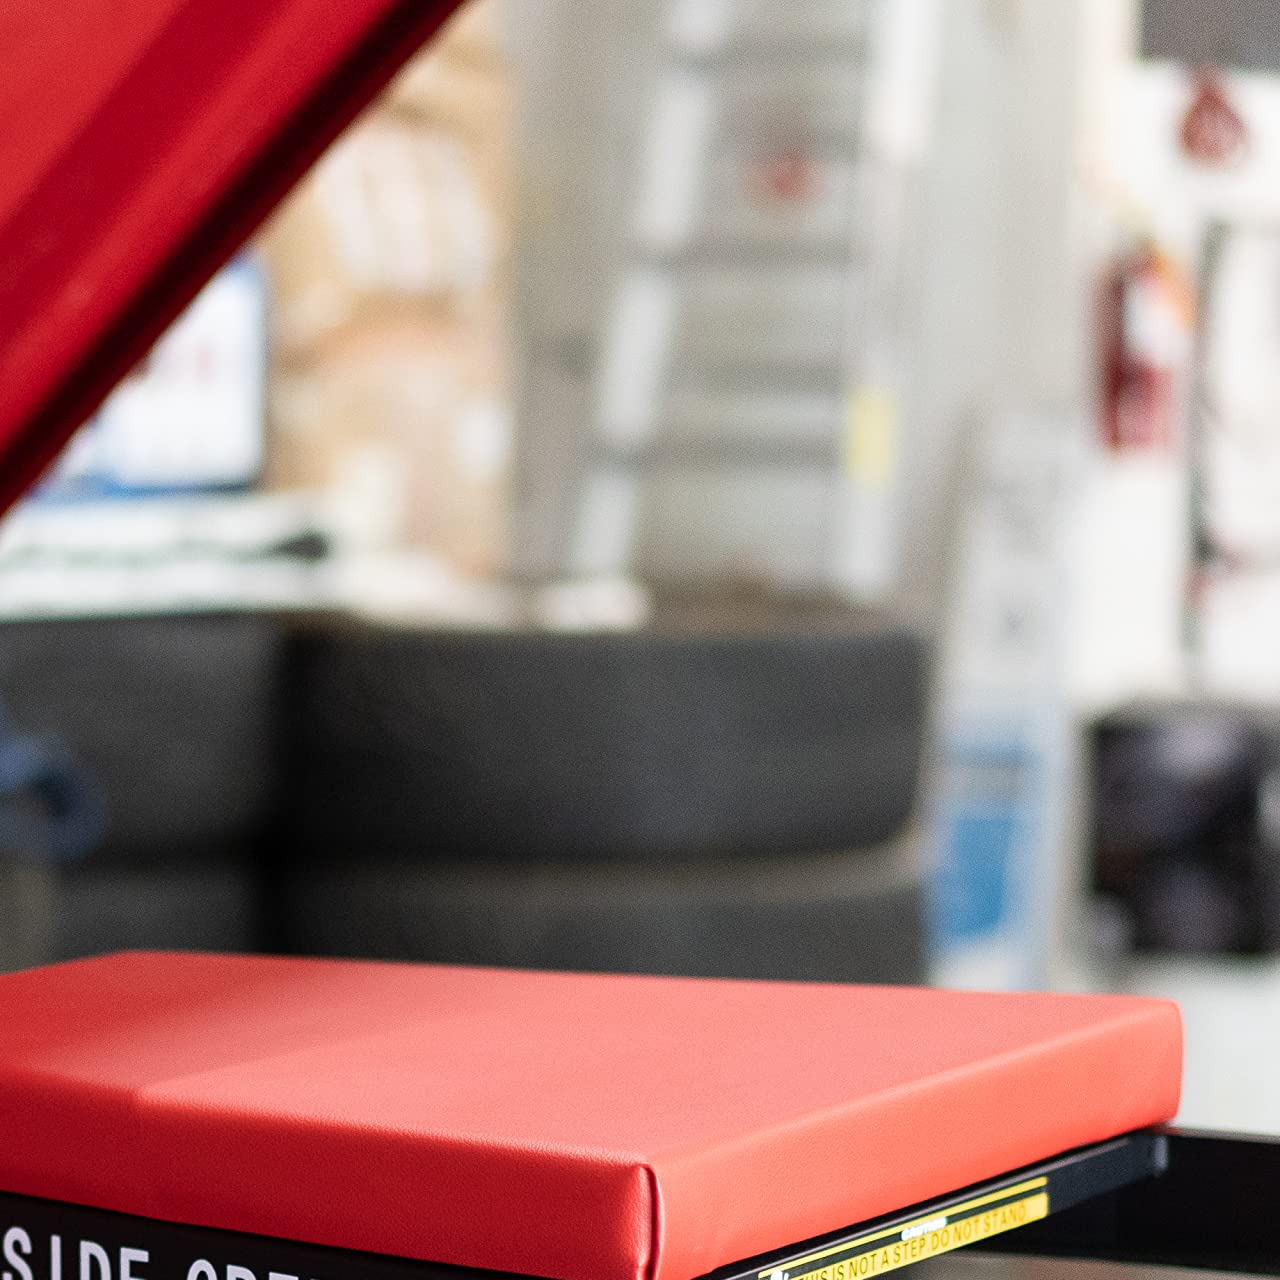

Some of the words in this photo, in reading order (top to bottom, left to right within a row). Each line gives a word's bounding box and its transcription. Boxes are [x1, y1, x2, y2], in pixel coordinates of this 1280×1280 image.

[849, 1253, 878, 1280] NOT
[881, 1249, 890, 1271] A
[931, 1229, 950, 1250] DO
[953, 1218, 980, 1242] NOT
[983, 1203, 1027, 1233] STAND
